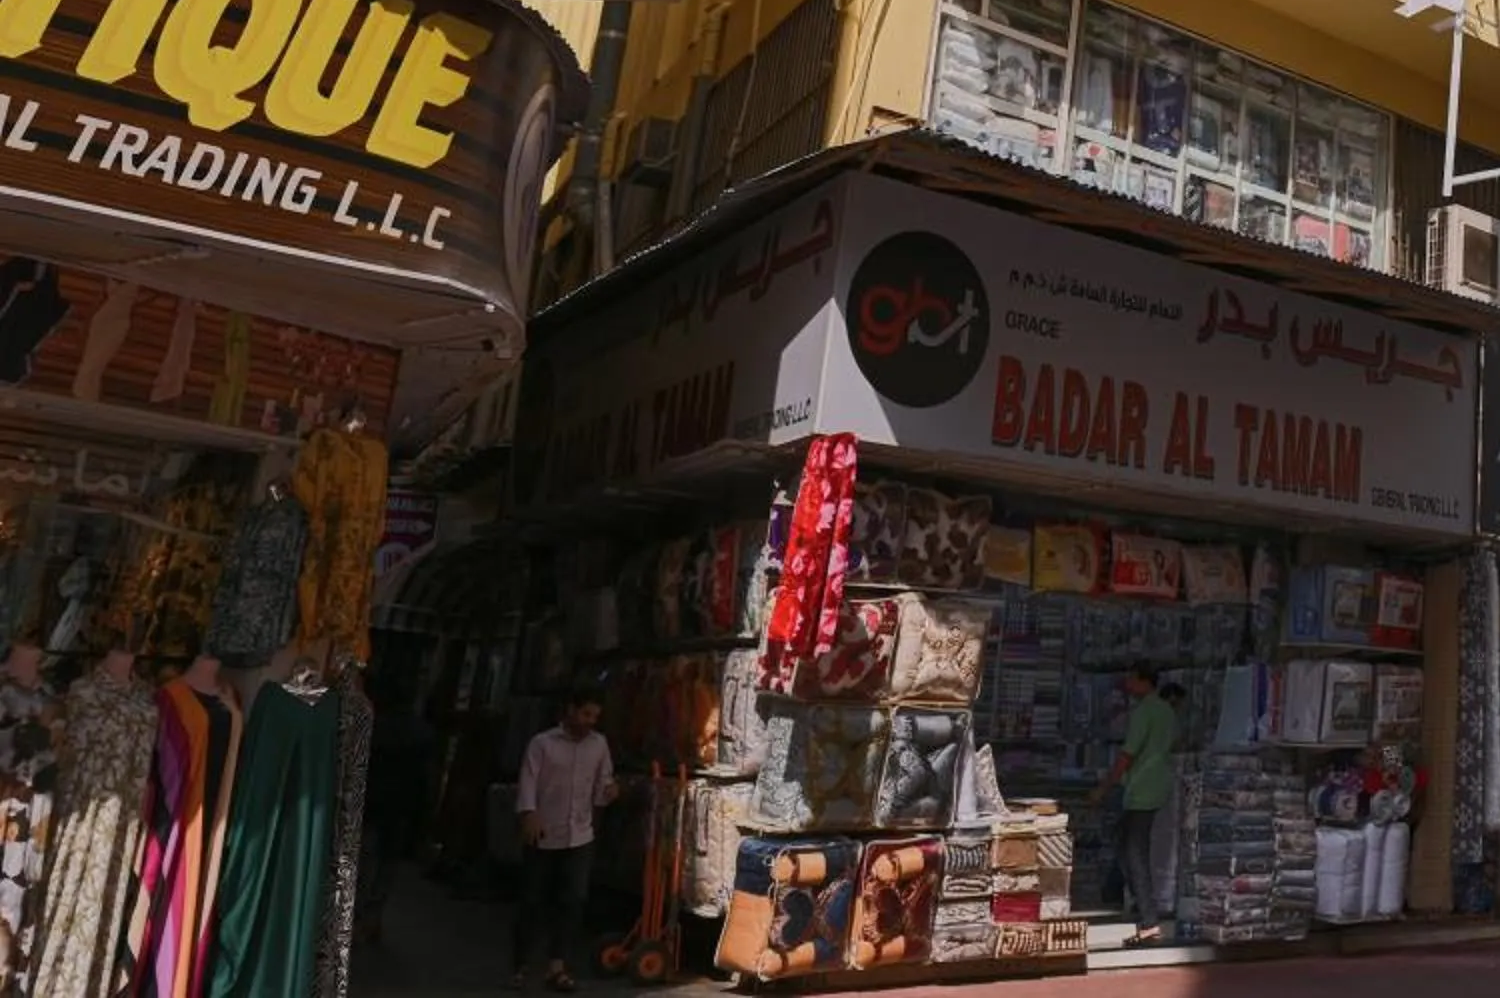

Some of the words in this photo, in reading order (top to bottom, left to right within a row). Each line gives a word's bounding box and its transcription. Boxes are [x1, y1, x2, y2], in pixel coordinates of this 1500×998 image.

[68, 114, 322, 215] TRADING
[332, 181, 452, 250] L.L.C
[1005, 309, 1063, 339] GRACE
[991, 354, 1149, 469] BADAR
[1163, 390, 1215, 481] AL
[1234, 402, 1364, 503] TAMAM
